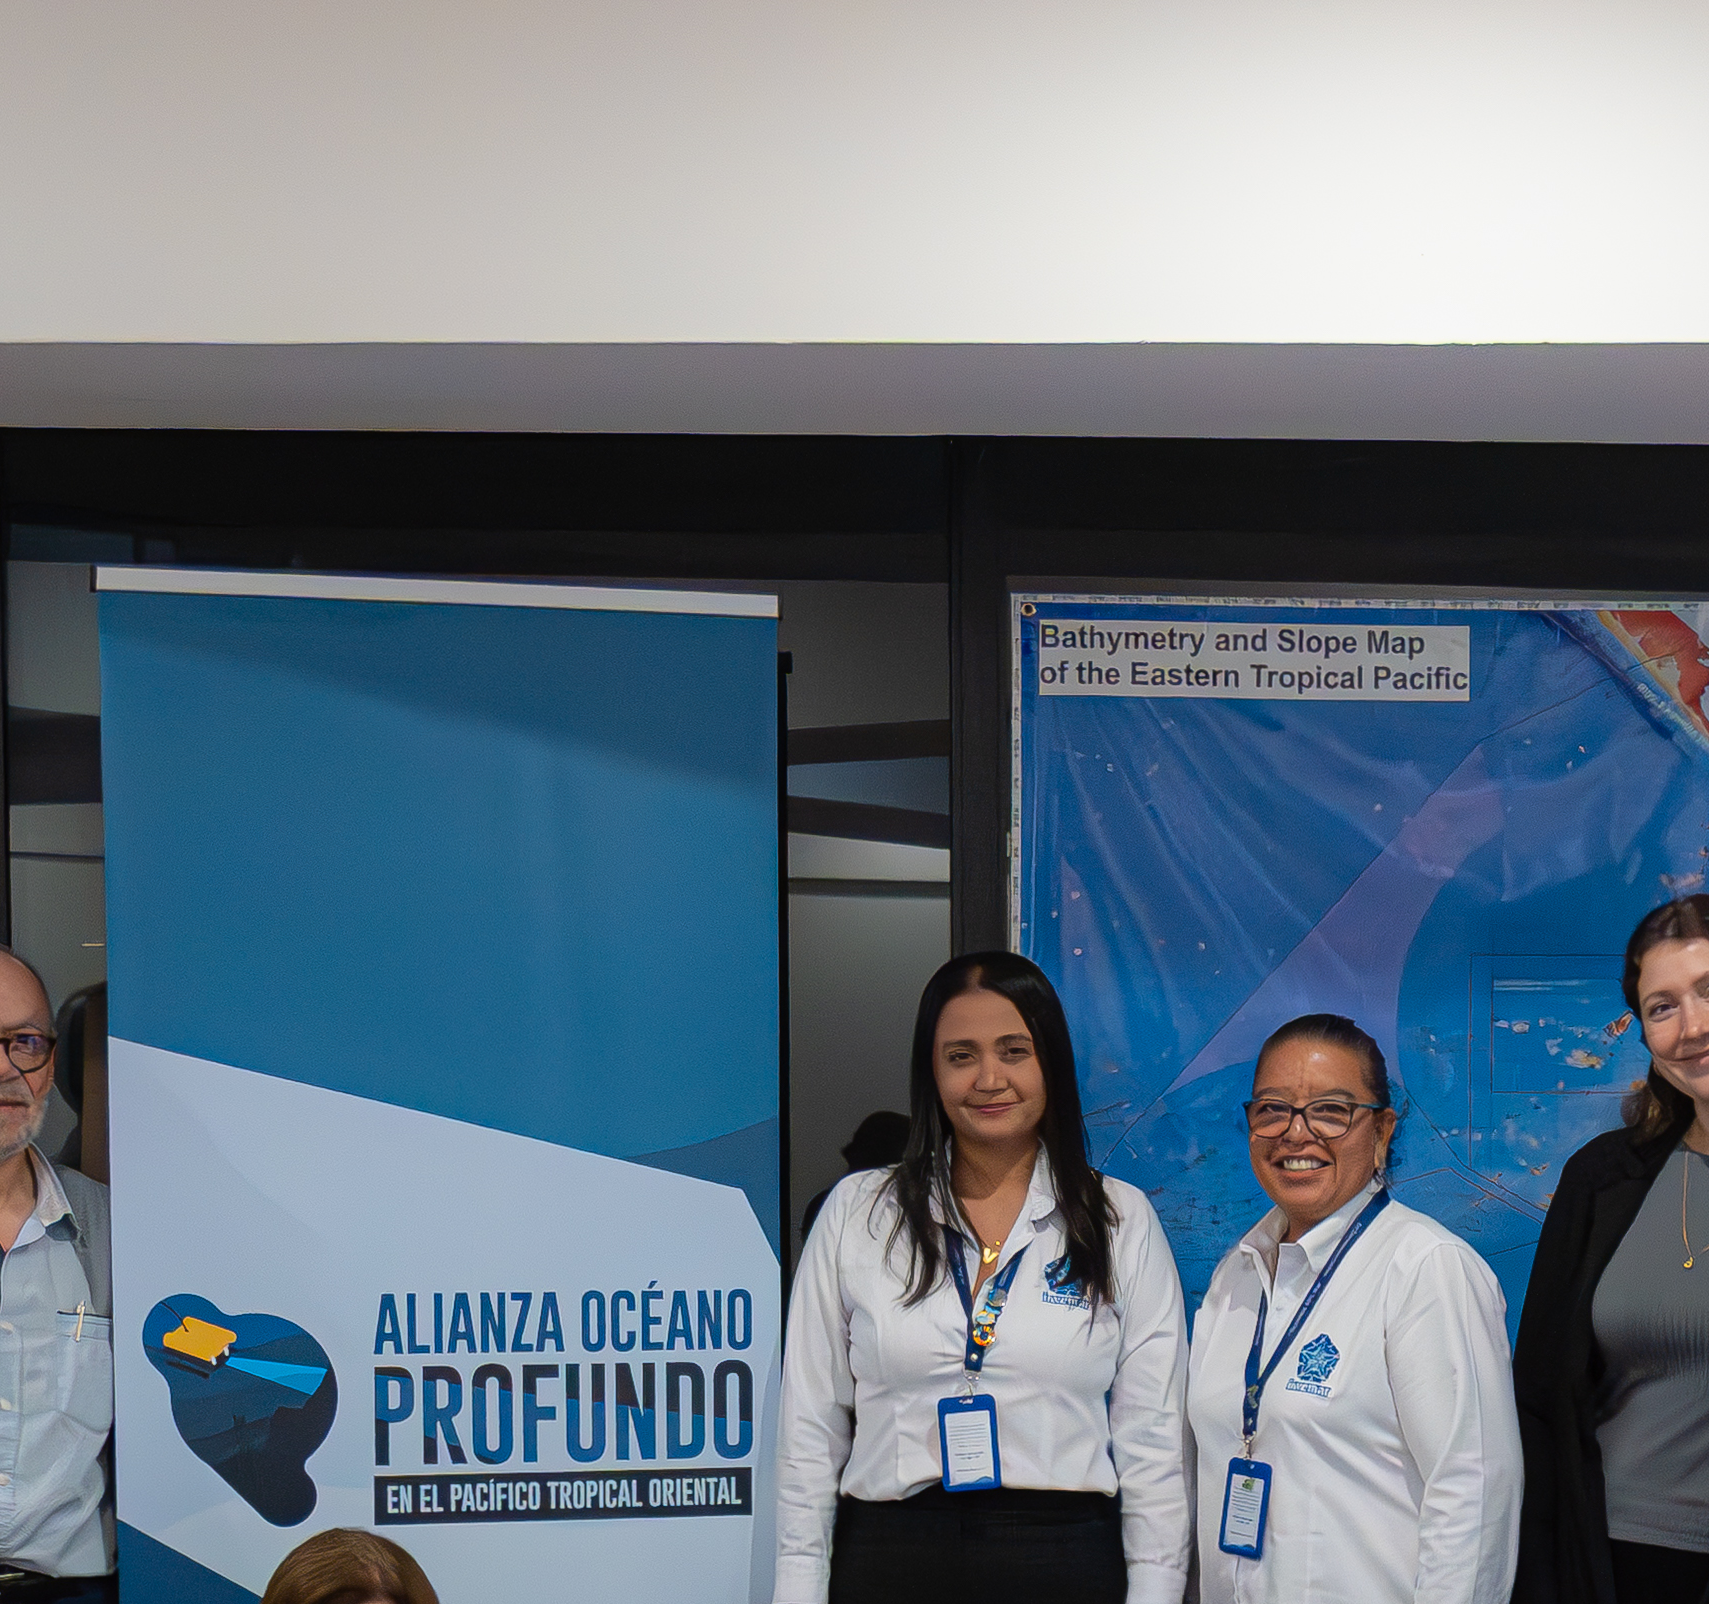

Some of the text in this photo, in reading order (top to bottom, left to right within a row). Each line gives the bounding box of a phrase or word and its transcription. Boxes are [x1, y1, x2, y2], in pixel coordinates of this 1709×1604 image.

[1041, 623, 1425, 660] Bathymetry and Slope Map
[1040, 661, 1469, 694] of the Eastern Tropical Pacific
[374, 1281, 753, 1355] ALIANZA OCÉANO
[1285, 1377, 1332, 1398] invemar
[374, 1359, 753, 1466] PROFUNDO
[386, 1476, 742, 1514] EN EL PACÍFICO TROPICAL ORIENTAL
